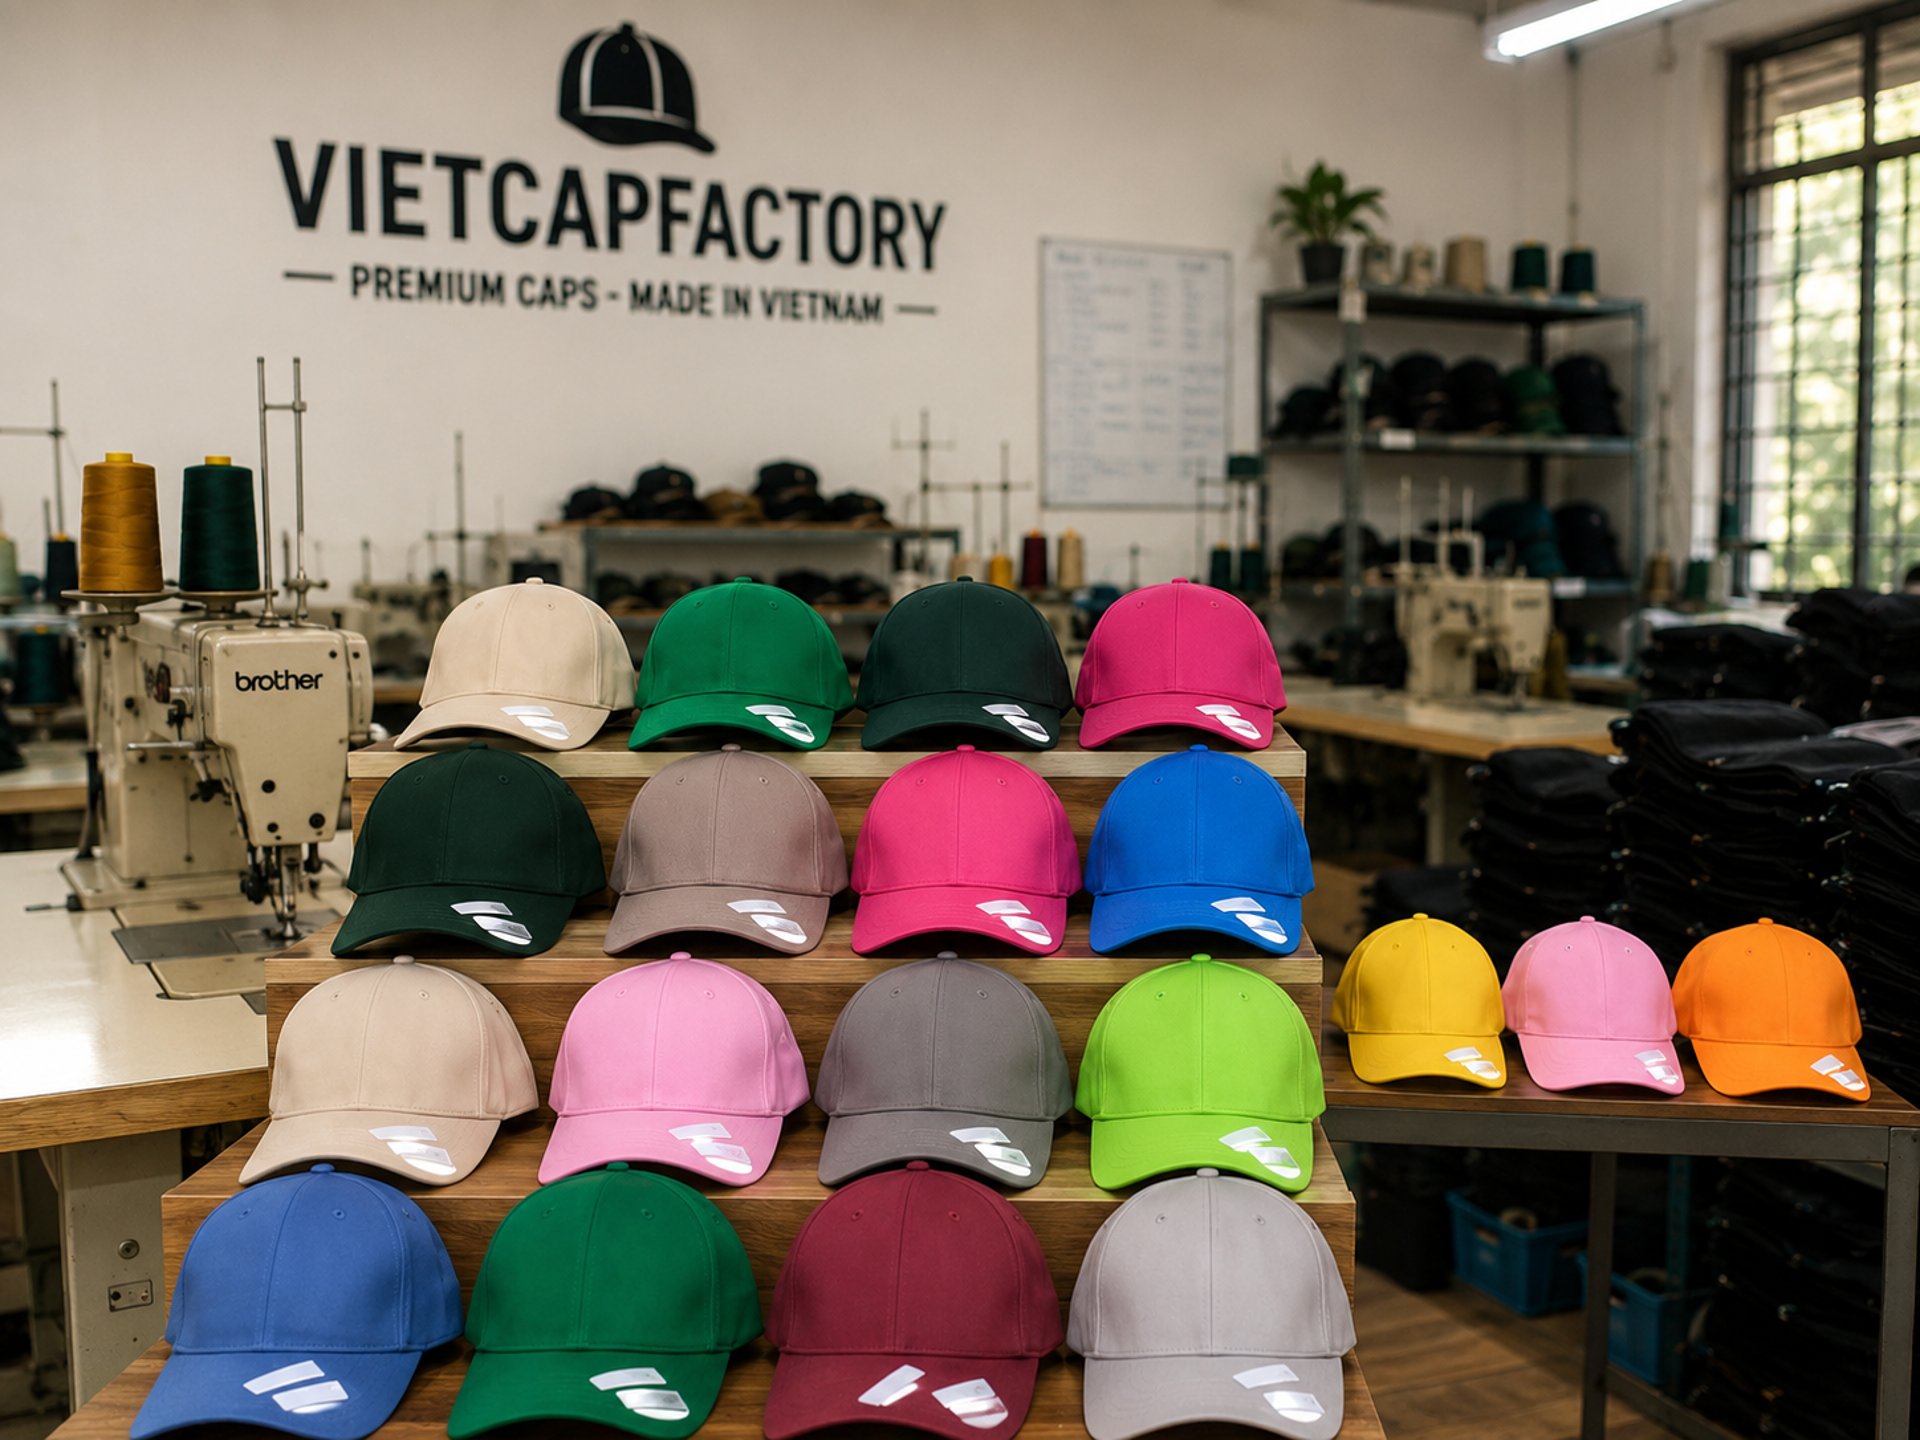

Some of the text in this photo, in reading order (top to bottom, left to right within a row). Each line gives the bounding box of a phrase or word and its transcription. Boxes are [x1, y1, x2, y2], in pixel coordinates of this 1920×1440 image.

[273, 137, 947, 273] VIETCAPFACTORY
[351, 264, 505, 306] PREMIUM
[516, 274, 598, 311] CAPS
[629, 281, 712, 317] MADE
[722, 286, 751, 318] IN
[760, 288, 883, 324] VIETNAM
[234, 669, 324, 692] brother
